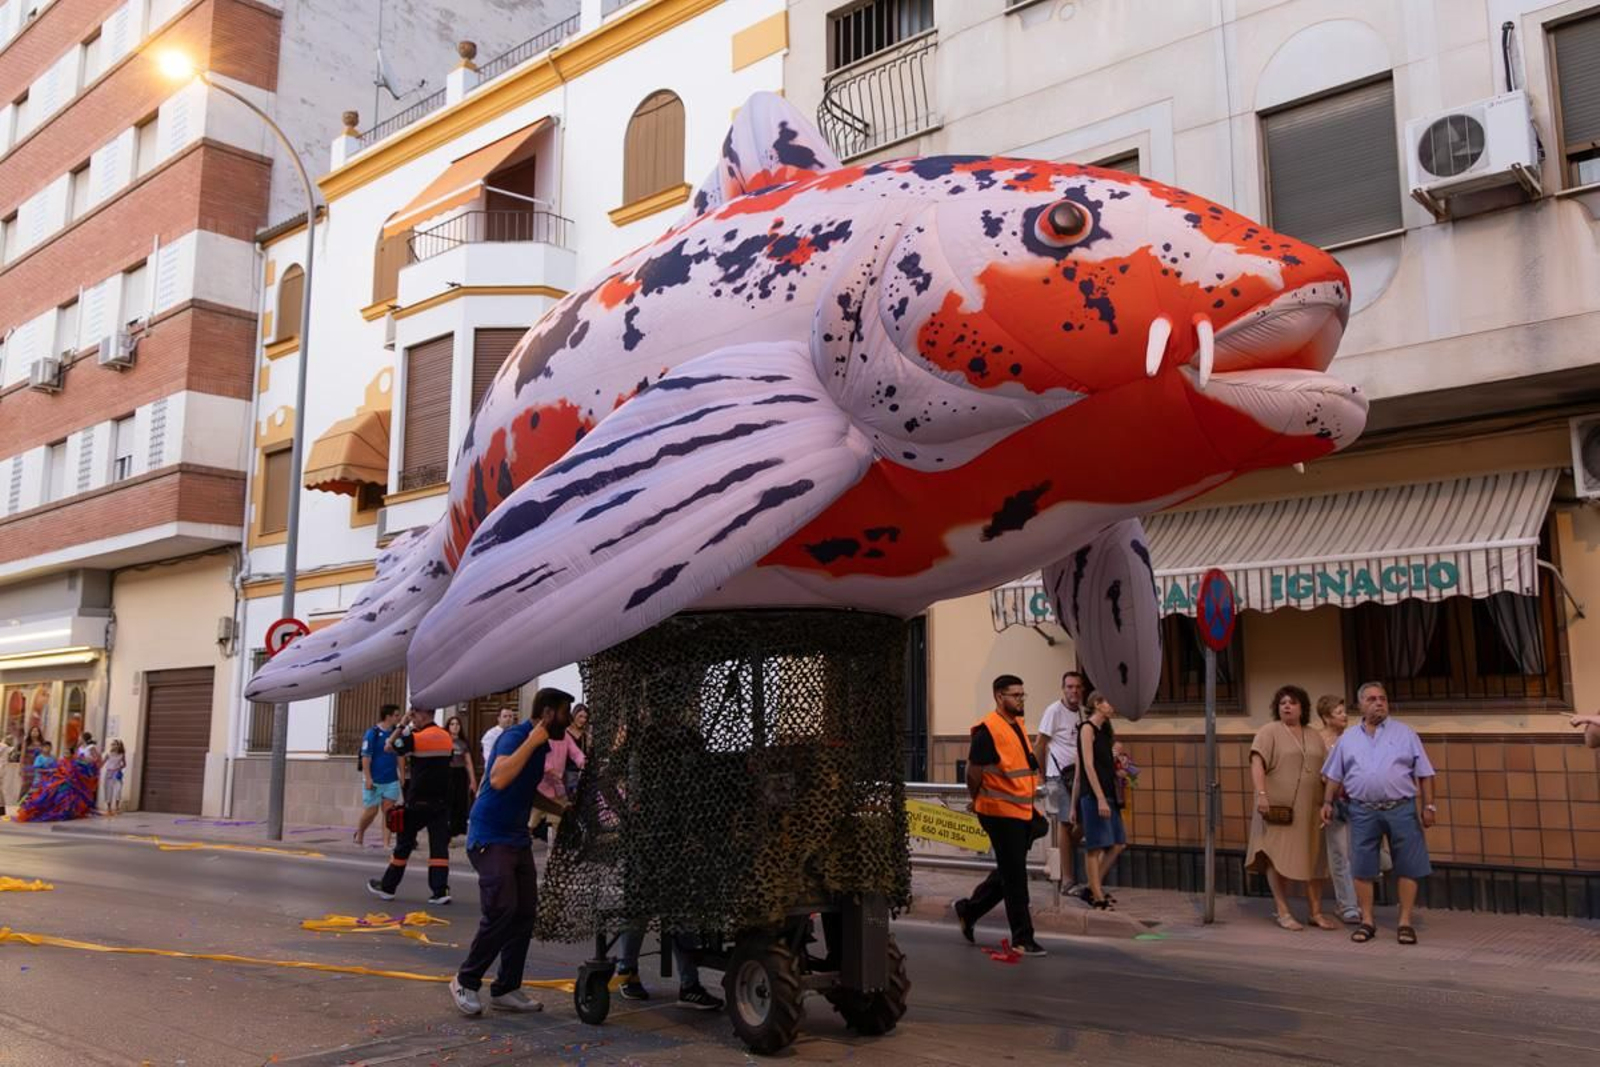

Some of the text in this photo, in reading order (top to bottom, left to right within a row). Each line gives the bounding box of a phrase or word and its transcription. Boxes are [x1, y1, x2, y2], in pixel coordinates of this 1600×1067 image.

[1271, 561, 1460, 600] IGNACIO
[922, 814, 934, 825] SU
[935, 817, 988, 837] PUBLICIDAD
